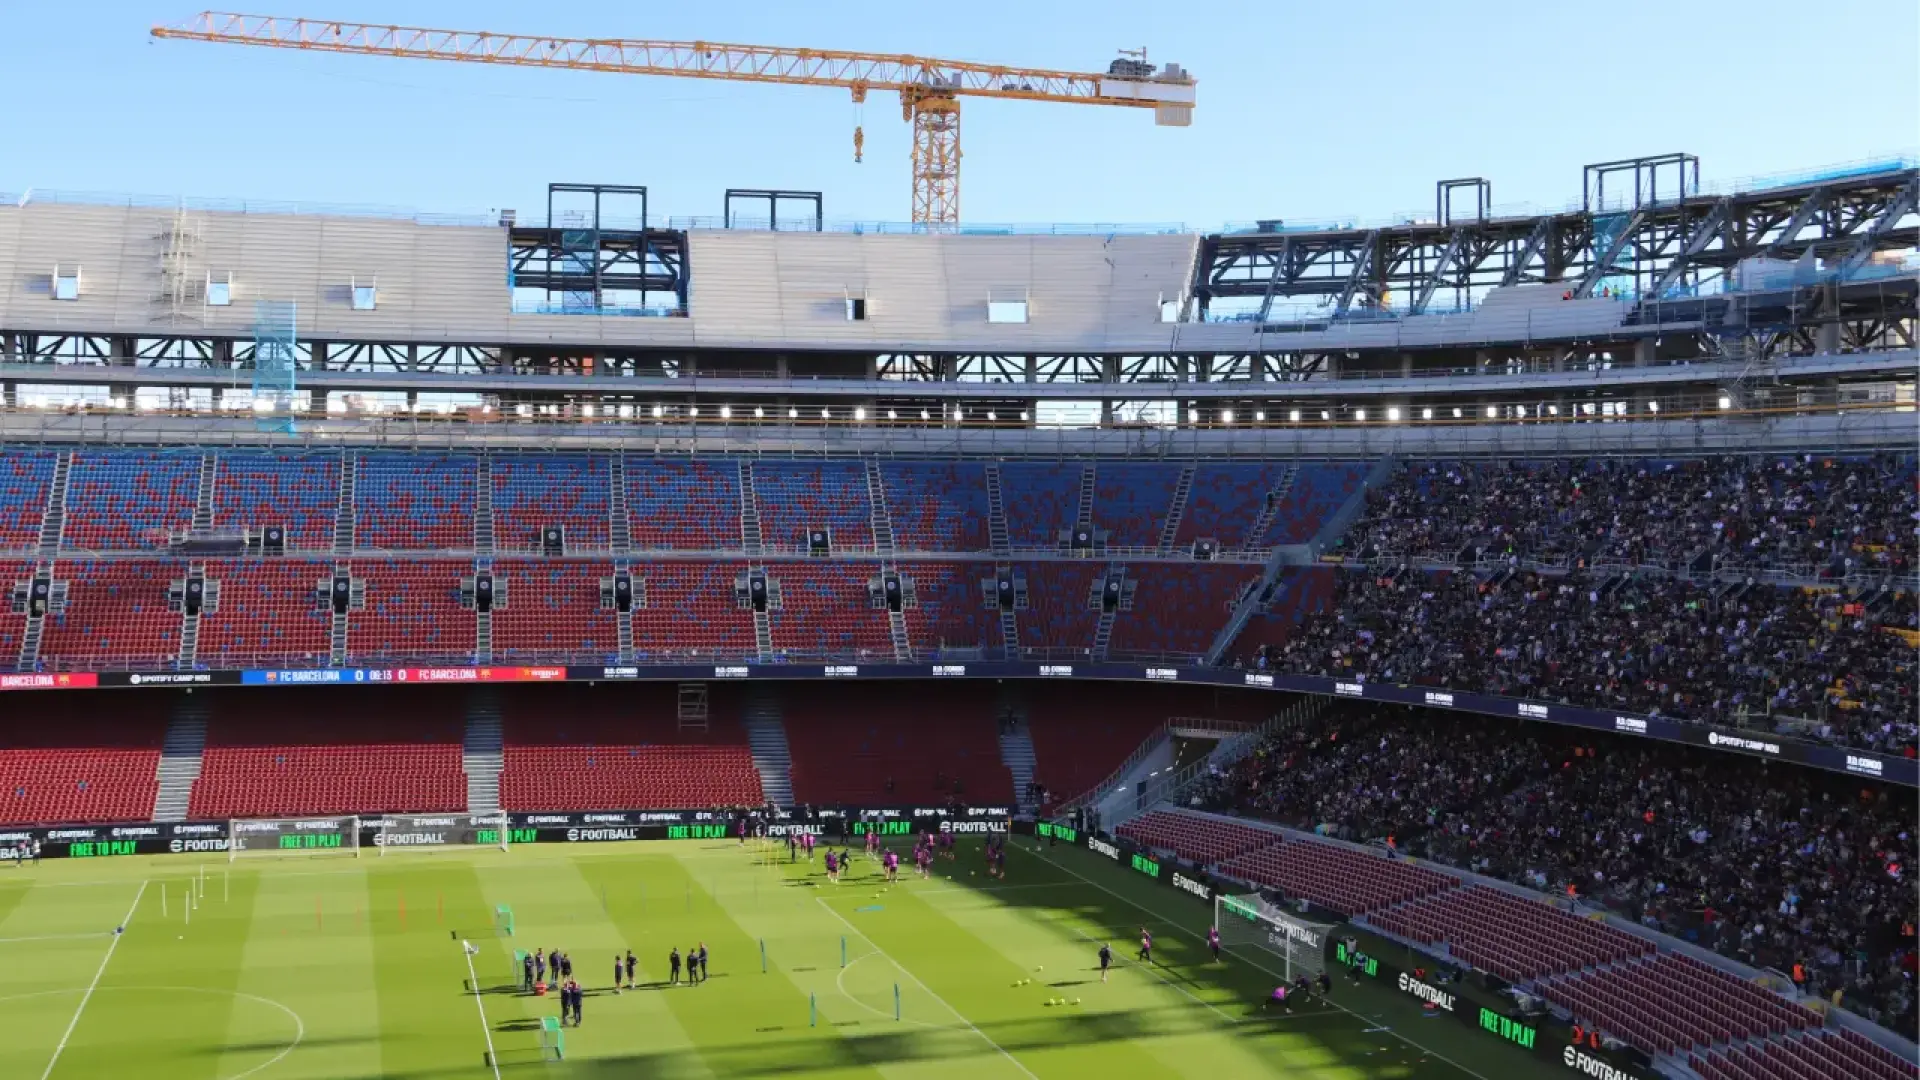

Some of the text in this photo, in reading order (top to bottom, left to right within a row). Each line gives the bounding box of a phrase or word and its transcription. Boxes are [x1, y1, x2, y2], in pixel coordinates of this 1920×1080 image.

[280, 671, 291, 682] FC
[292, 671, 340, 682] BARCELONA
[355, 670, 363, 681] 0
[398, 669, 407, 680] 0
[419, 669, 429, 680] FC
[430, 668, 476, 680] BARCELONA
[514, 829, 537, 842] PLAY
[668, 825, 727, 838] FREE TO PLAY
[280, 834, 341, 848] FREE TO PLAY
[70, 841, 136, 856] FREE TO PLAY
[1480, 1008, 1536, 1049] FREE TO PLAY
